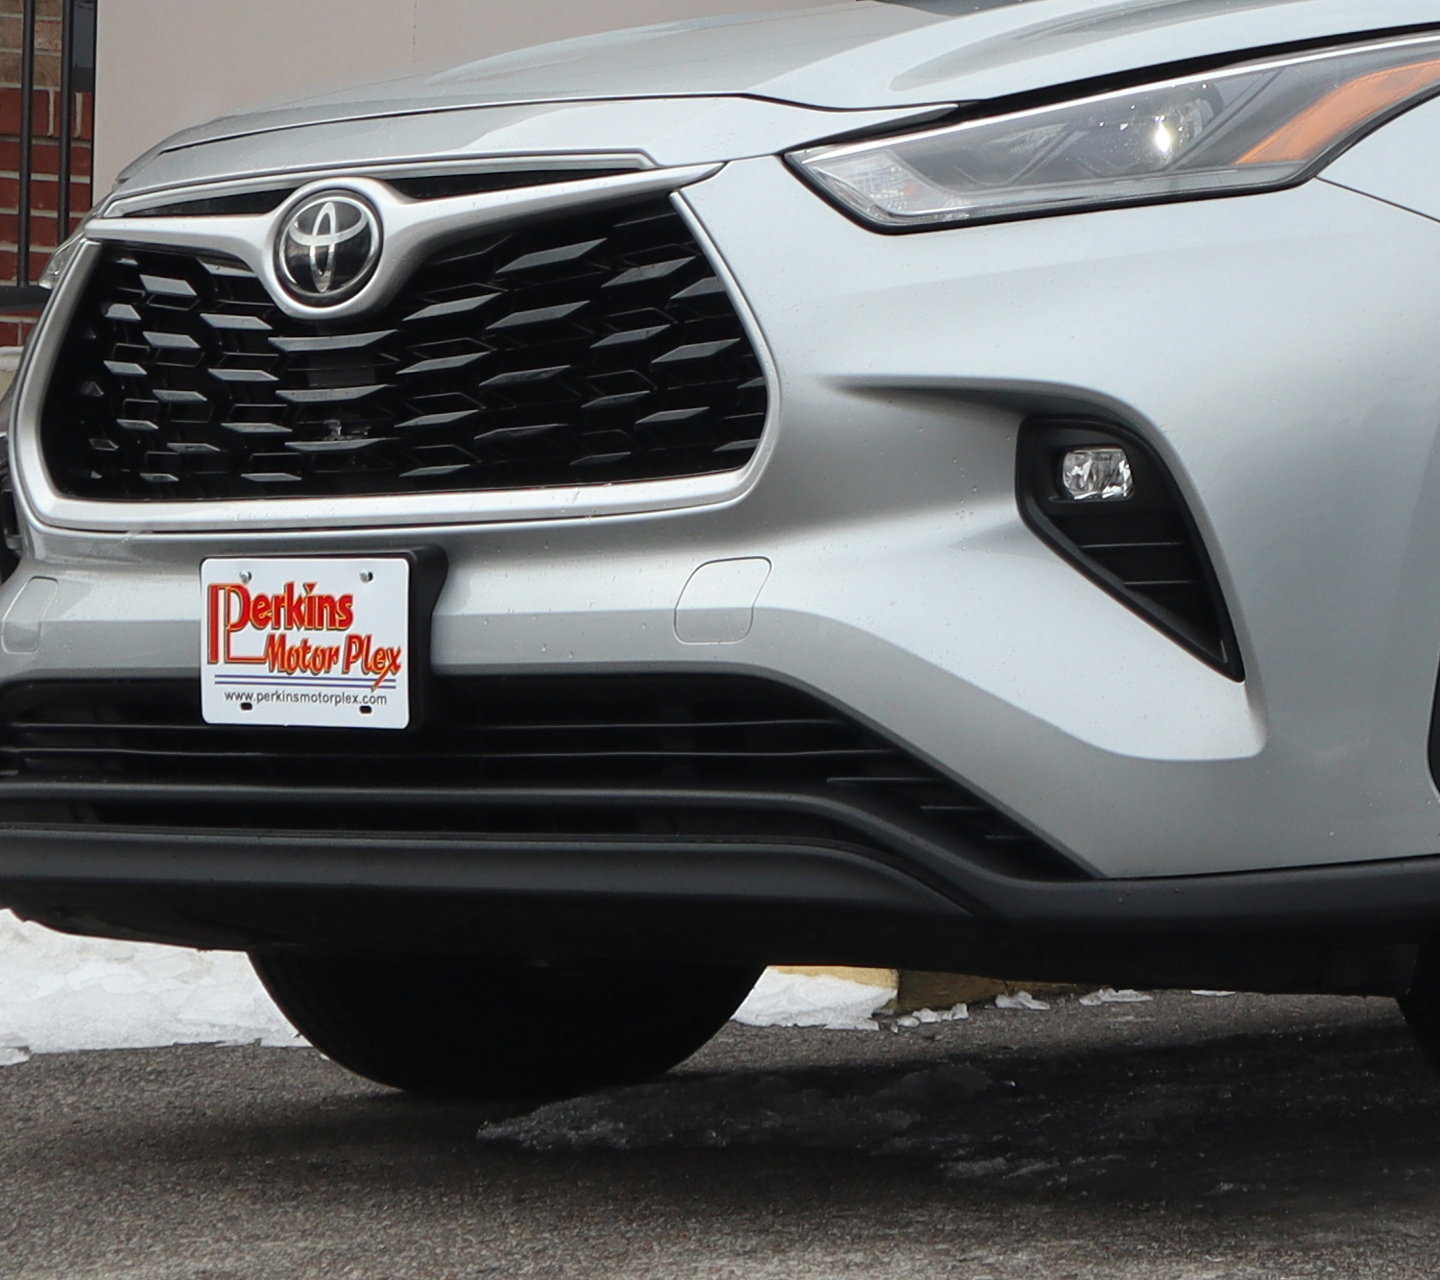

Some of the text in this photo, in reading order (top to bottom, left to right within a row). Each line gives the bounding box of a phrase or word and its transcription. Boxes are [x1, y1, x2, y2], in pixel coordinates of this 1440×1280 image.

[207, 580, 354, 664] Perkins
[265, 632, 402, 692] Motor Plex
[224, 690, 388, 706] www.perkinsmotorplex.com
